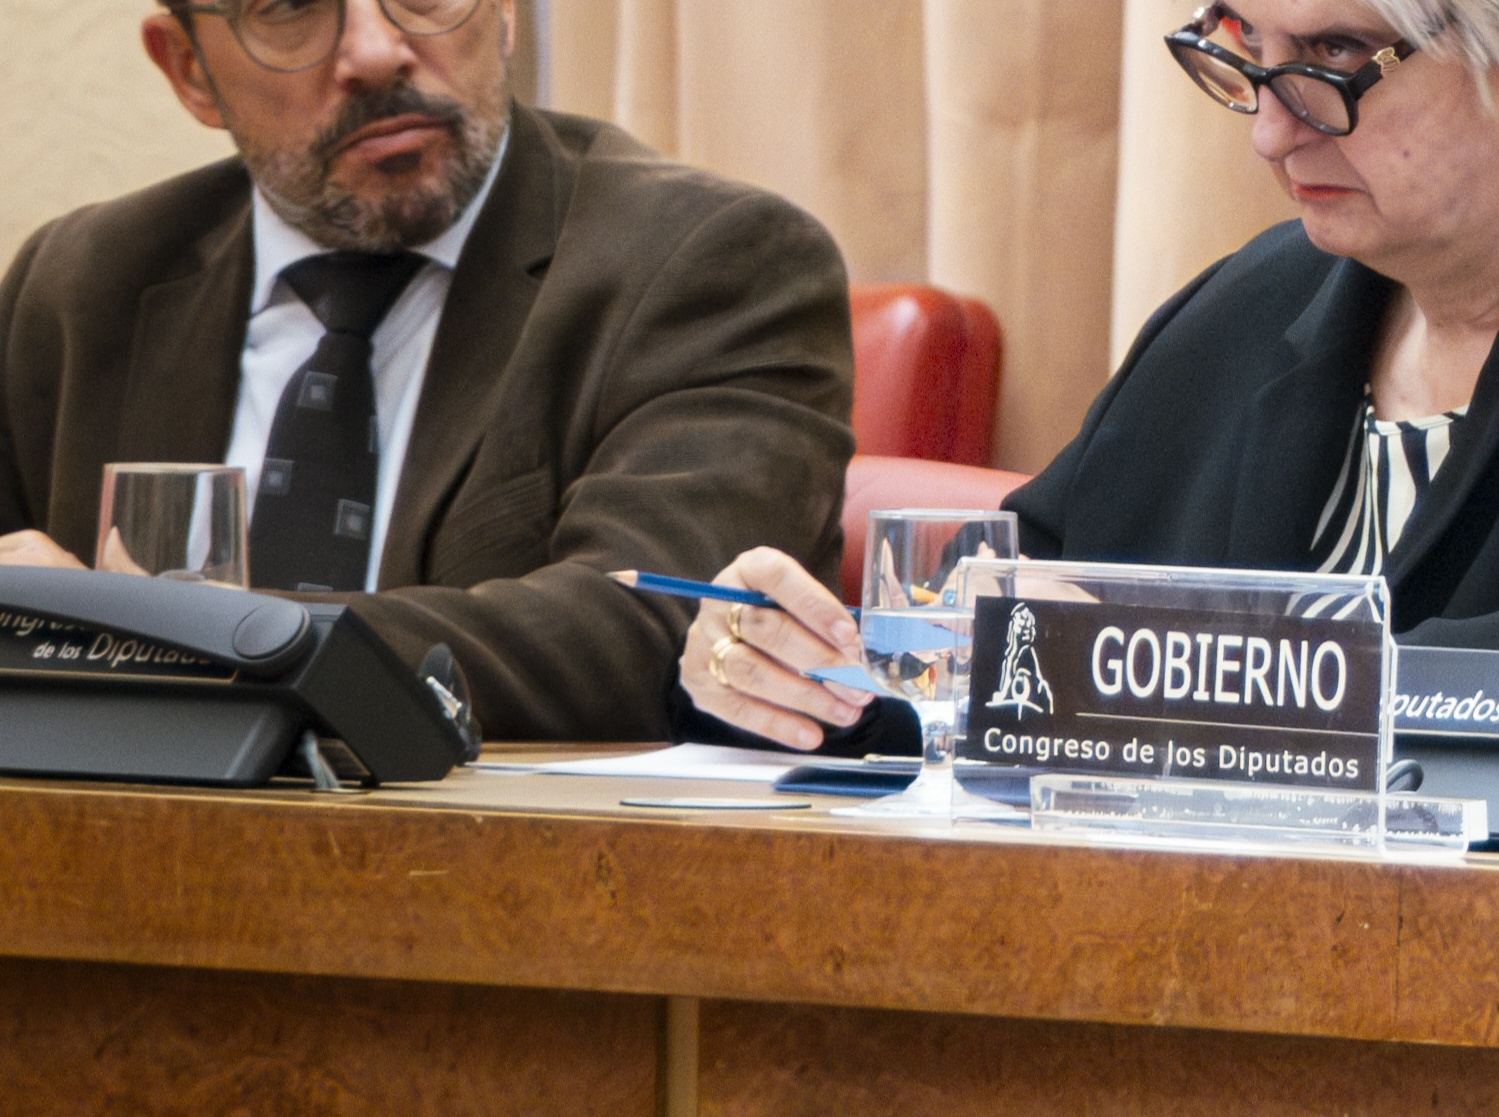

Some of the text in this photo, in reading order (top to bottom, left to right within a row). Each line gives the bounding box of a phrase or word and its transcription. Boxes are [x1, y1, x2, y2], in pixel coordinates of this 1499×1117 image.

[33, 641, 56, 658] de
[57, 642, 83, 660] los
[1091, 626, 1347, 711] GOBIERNO
[984, 727, 1359, 781] Congreso de los Diputados
